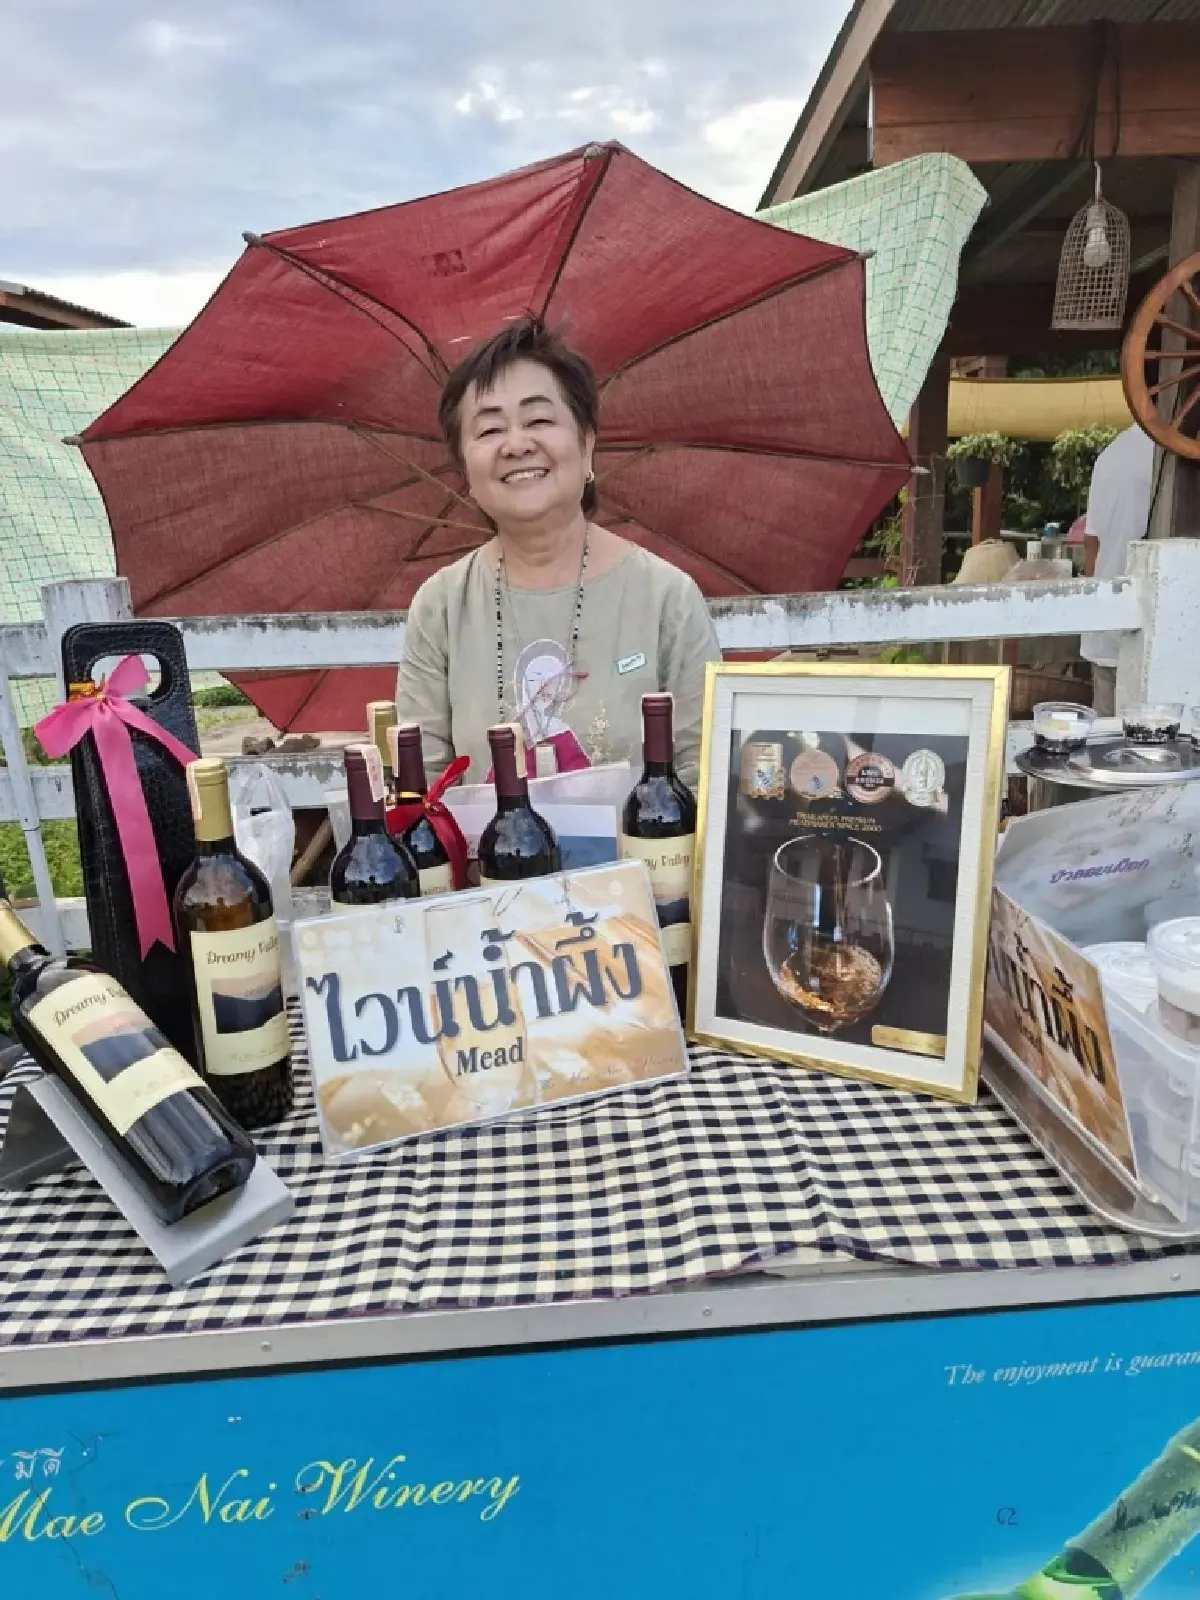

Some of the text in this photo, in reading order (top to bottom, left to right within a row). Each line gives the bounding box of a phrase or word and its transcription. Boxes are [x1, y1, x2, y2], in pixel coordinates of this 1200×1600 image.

[305, 911, 643, 1063] ไวน์น้ำผึ้ง
[53, 992, 107, 1027] Dreamy
[456, 1036, 524, 1077] Mead
[944, 1363, 986, 1386] The
[993, 1355, 1100, 1387] enjoyment
[1105, 1352, 1123, 1373] is
[0, 1454, 520, 1542] Mae Nai Winery
